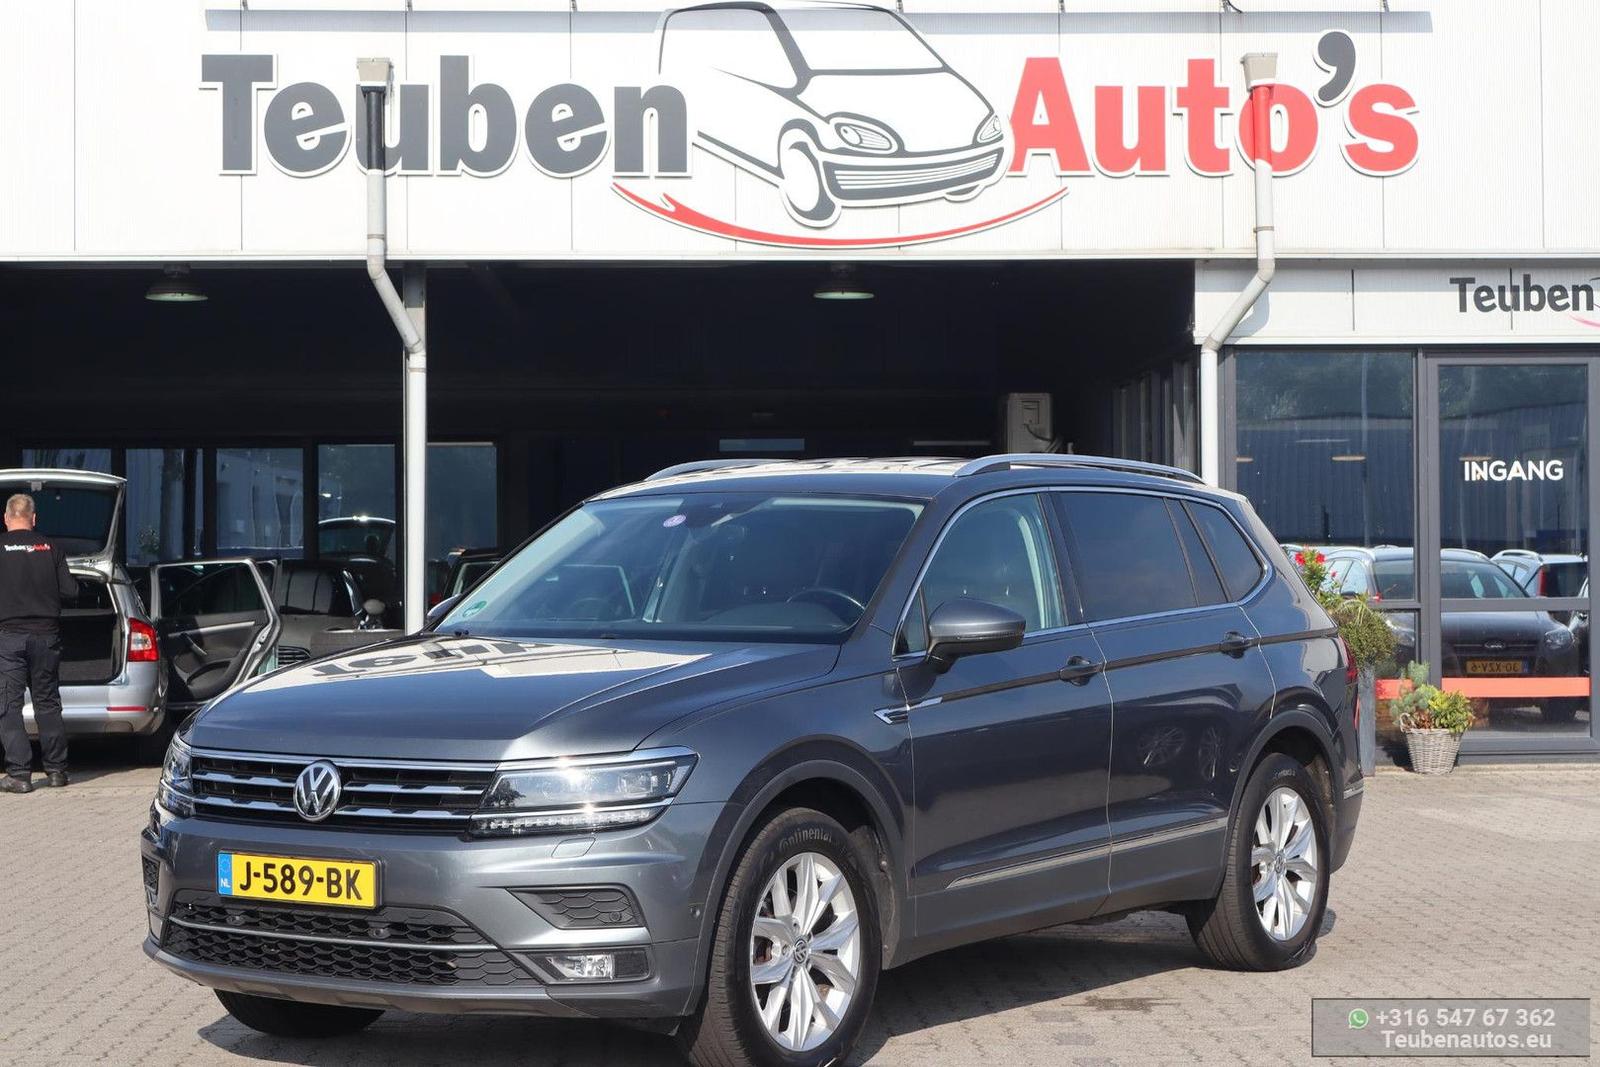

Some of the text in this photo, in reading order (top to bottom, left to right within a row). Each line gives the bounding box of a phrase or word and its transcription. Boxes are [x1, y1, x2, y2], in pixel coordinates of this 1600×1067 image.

[201, 31, 1420, 175] Teuben Auto's
[1450, 274, 1594, 313] Teuben
[1464, 459, 1564, 481] INGANG
[220, 878, 231, 888] NL
[239, 861, 362, 901] J-589-BK
